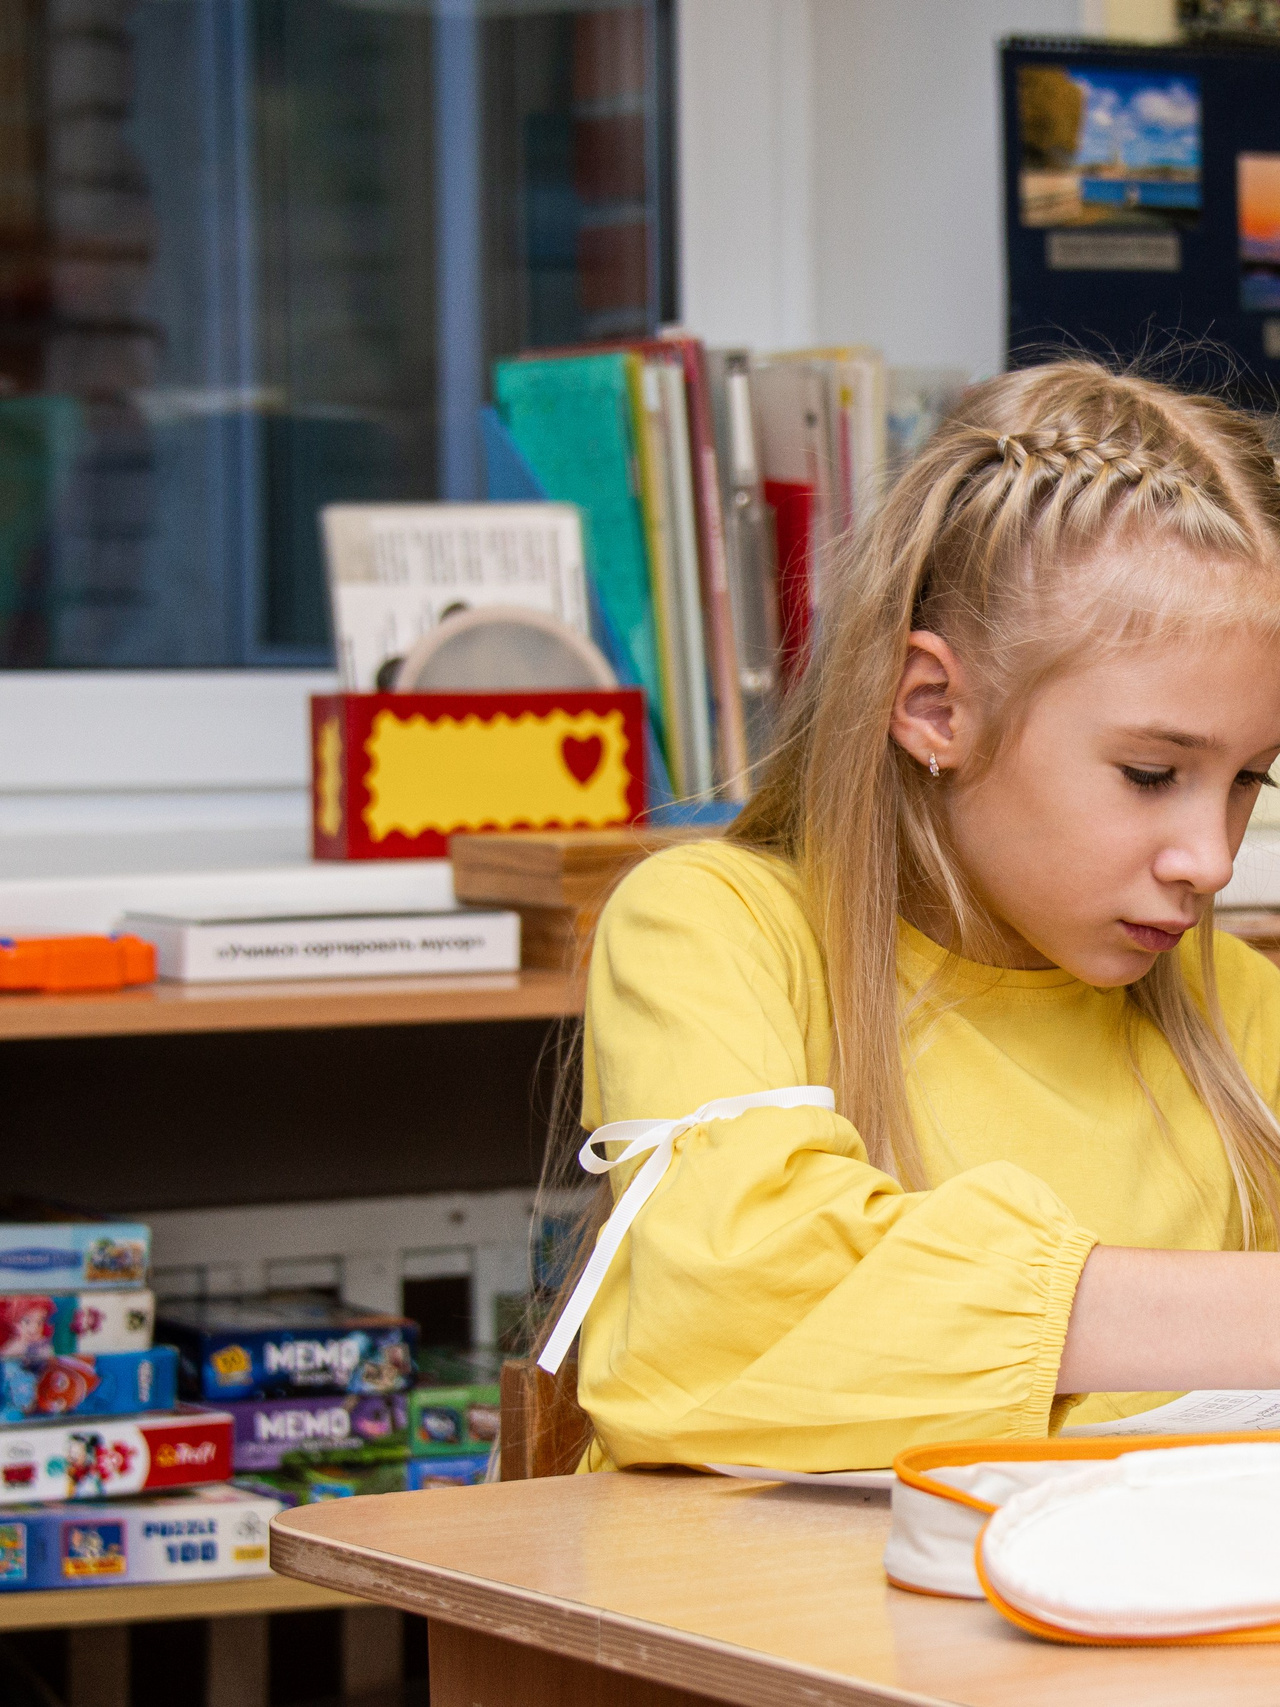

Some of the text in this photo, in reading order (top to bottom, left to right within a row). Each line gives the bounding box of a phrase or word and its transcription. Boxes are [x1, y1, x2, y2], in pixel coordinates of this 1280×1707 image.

[303, 937, 416, 958] сортировать
[264, 1340, 361, 1374] MEMO
[255, 1408, 351, 1440] MEMO
[144, 1518, 217, 1538] PUZZLE
[166, 1541, 218, 1563] 100
